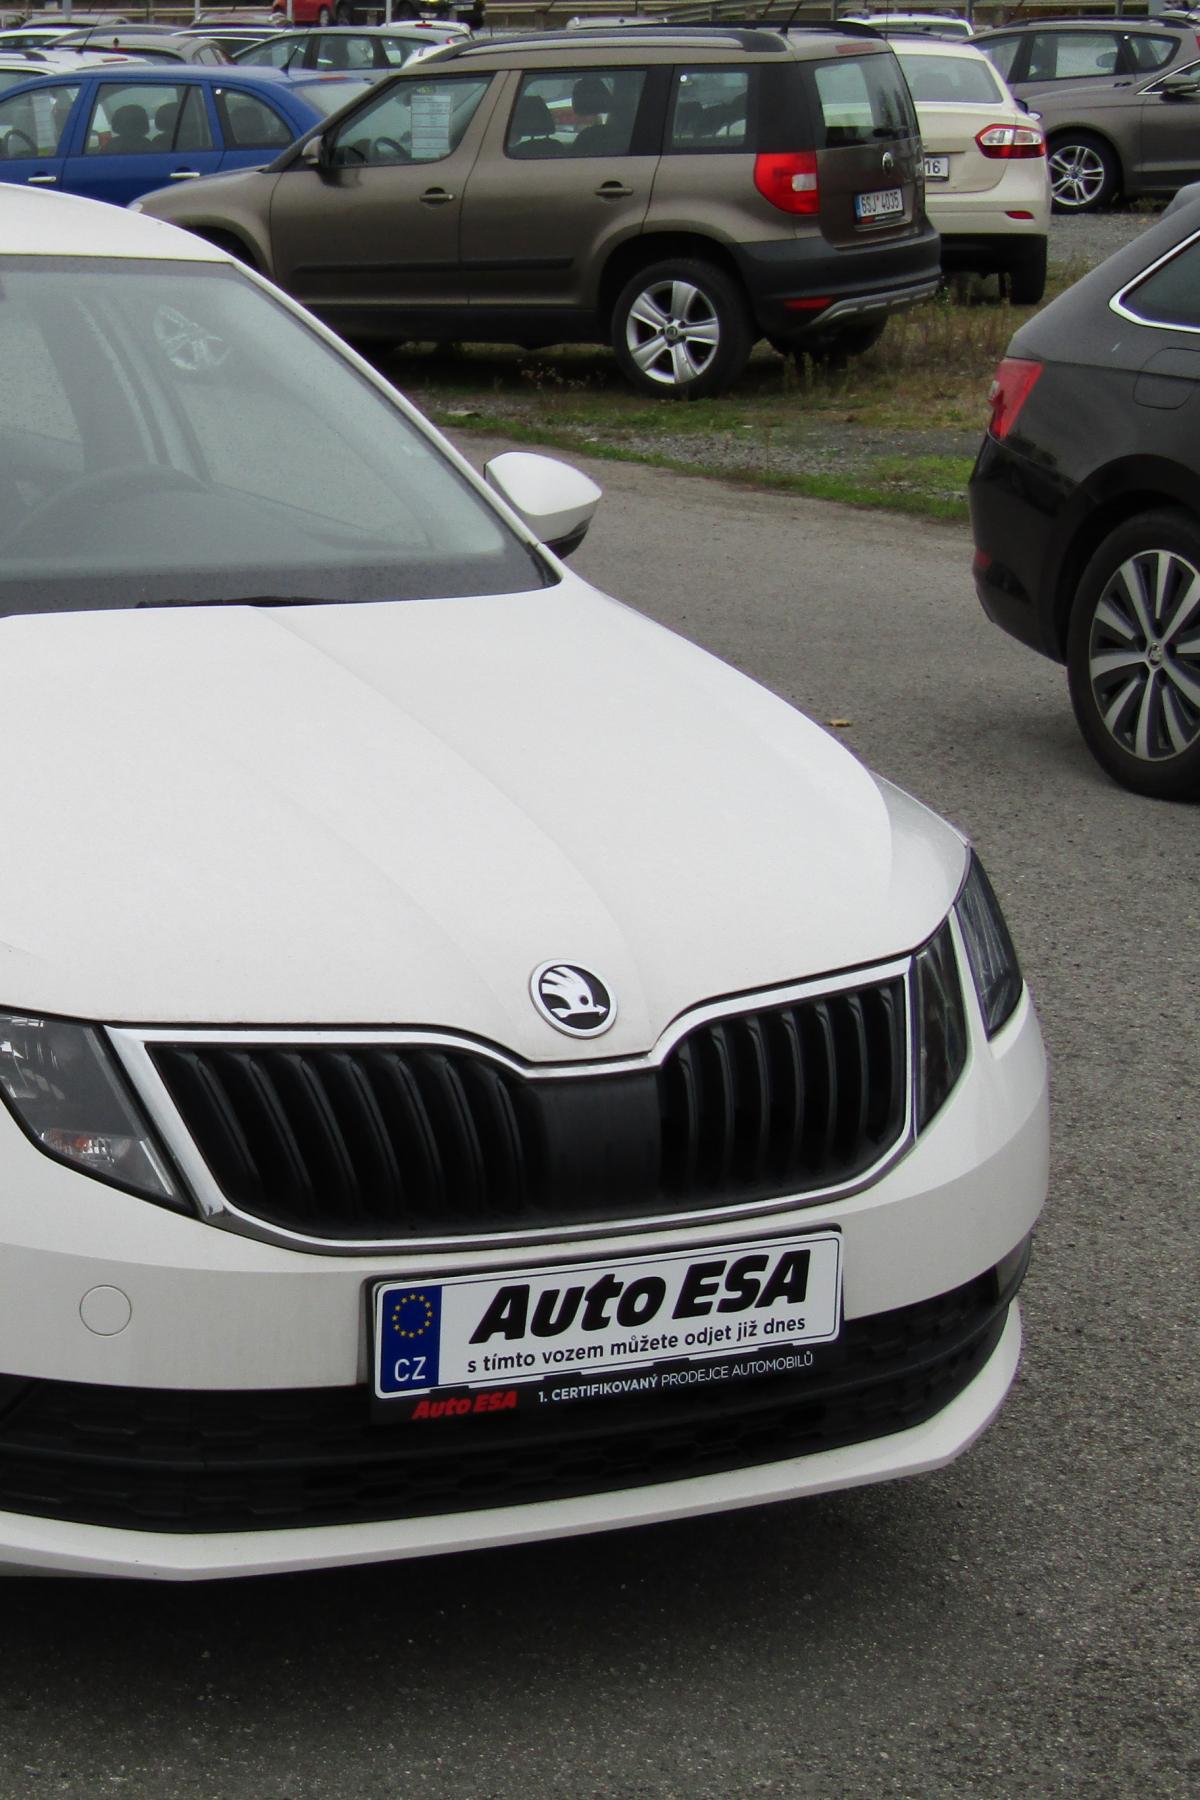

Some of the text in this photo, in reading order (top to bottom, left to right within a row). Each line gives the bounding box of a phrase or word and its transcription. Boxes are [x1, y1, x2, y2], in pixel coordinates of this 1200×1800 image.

[469, 1249, 811, 1345] Auto ESA
[394, 1356, 427, 1382] CZ
[467, 1317, 806, 1373] s tímto vozem můžete odjet již dnes
[538, 1350, 813, 1402] 1. CERTIFIKOVANÝ PRODEJCE AUTOMOBILŮ
[412, 1390, 518, 1420] Auto ESA
